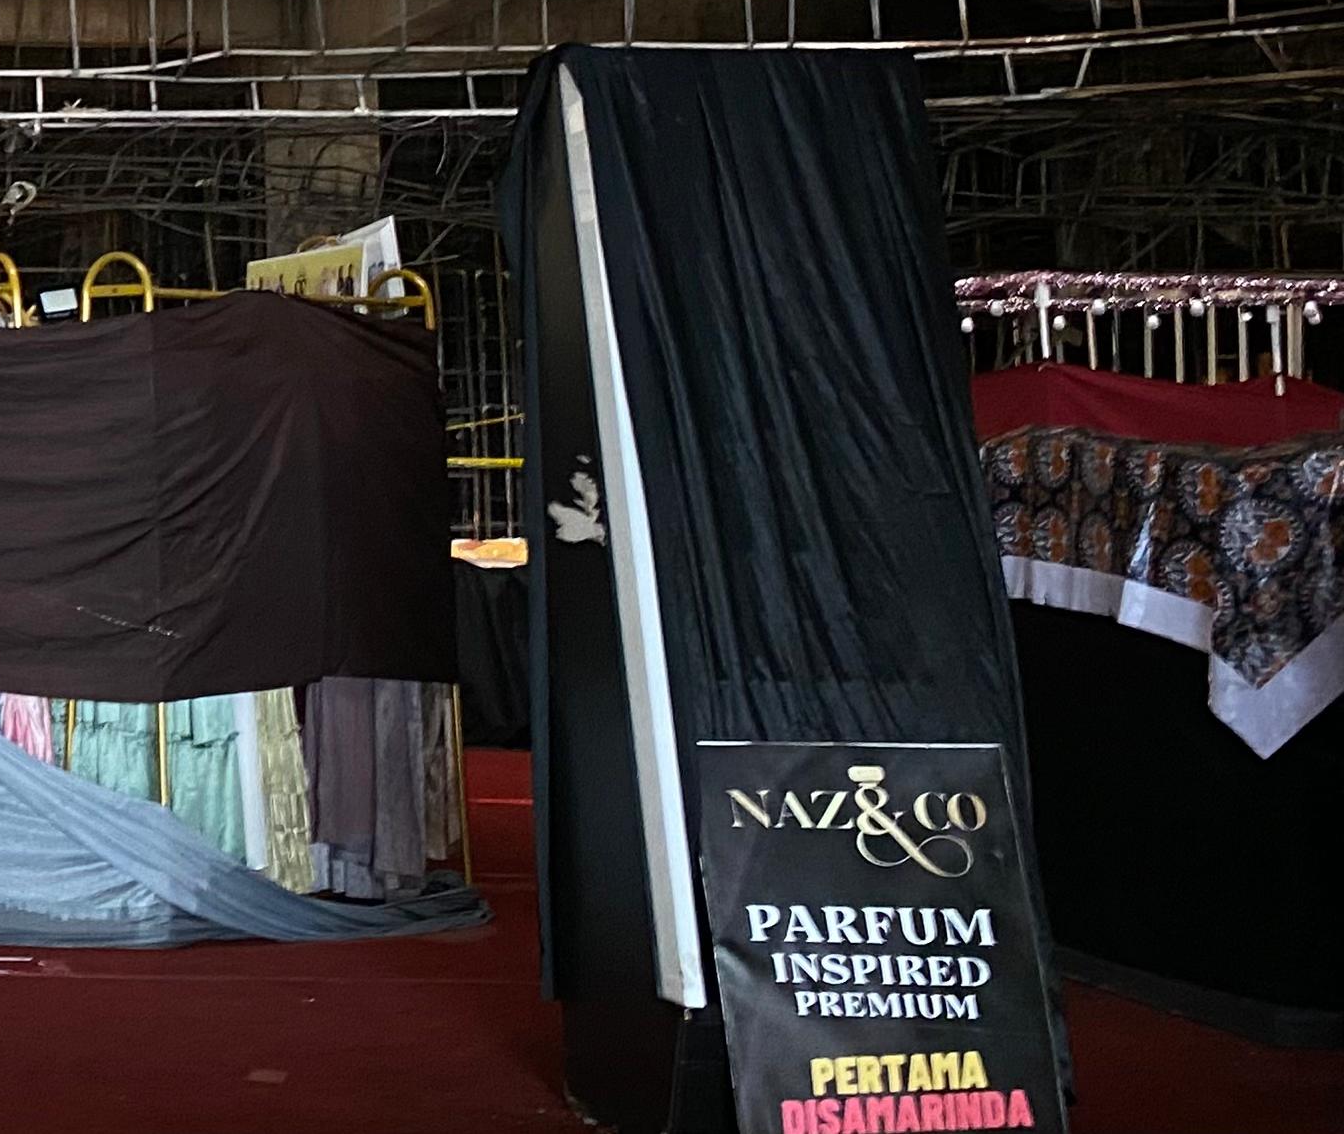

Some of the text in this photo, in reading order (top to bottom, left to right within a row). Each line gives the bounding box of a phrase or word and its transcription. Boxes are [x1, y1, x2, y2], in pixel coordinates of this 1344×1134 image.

[746, 904, 998, 947] PARFUM
[771, 952, 993, 987] INSPIRED
[794, 990, 981, 1020] PREMIUM
[810, 1050, 989, 1097] PERTAMA
[780, 1088, 1035, 1134] DISAMARINDA
